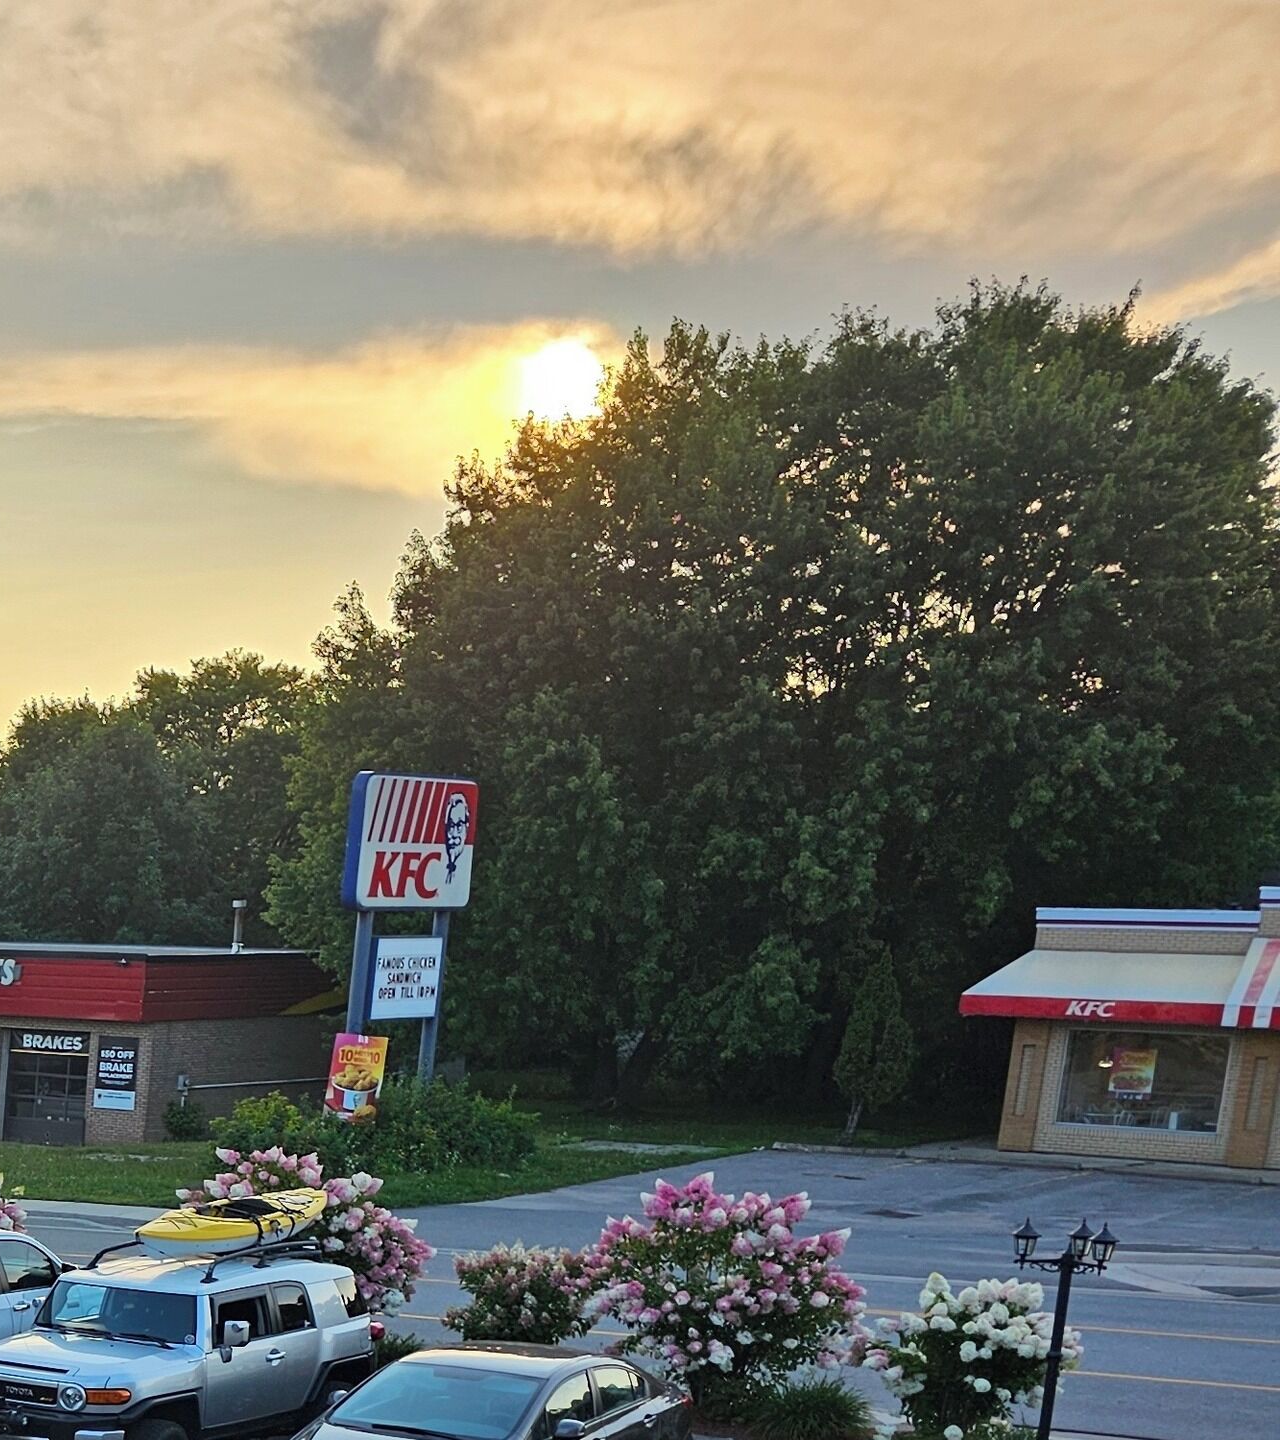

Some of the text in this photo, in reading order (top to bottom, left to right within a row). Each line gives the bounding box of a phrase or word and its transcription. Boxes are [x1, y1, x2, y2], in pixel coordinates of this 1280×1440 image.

[367, 851, 442, 899] KFC
[377, 956, 436, 969] FAMOUS CHICKEN
[387, 972, 422, 985] SANDWICH
[378, 987, 396, 999] OPEN
[401, 986, 414, 998] TILL
[1065, 1000, 1116, 1018] KFC
[22, 1033, 83, 1051] BRAKES
[100, 1050, 135, 1060] $50 OFF
[340, 1049, 354, 1062] 10
[99, 1062, 134, 1073] BRAKE
[5, 1385, 34, 1397] TOYOTA
